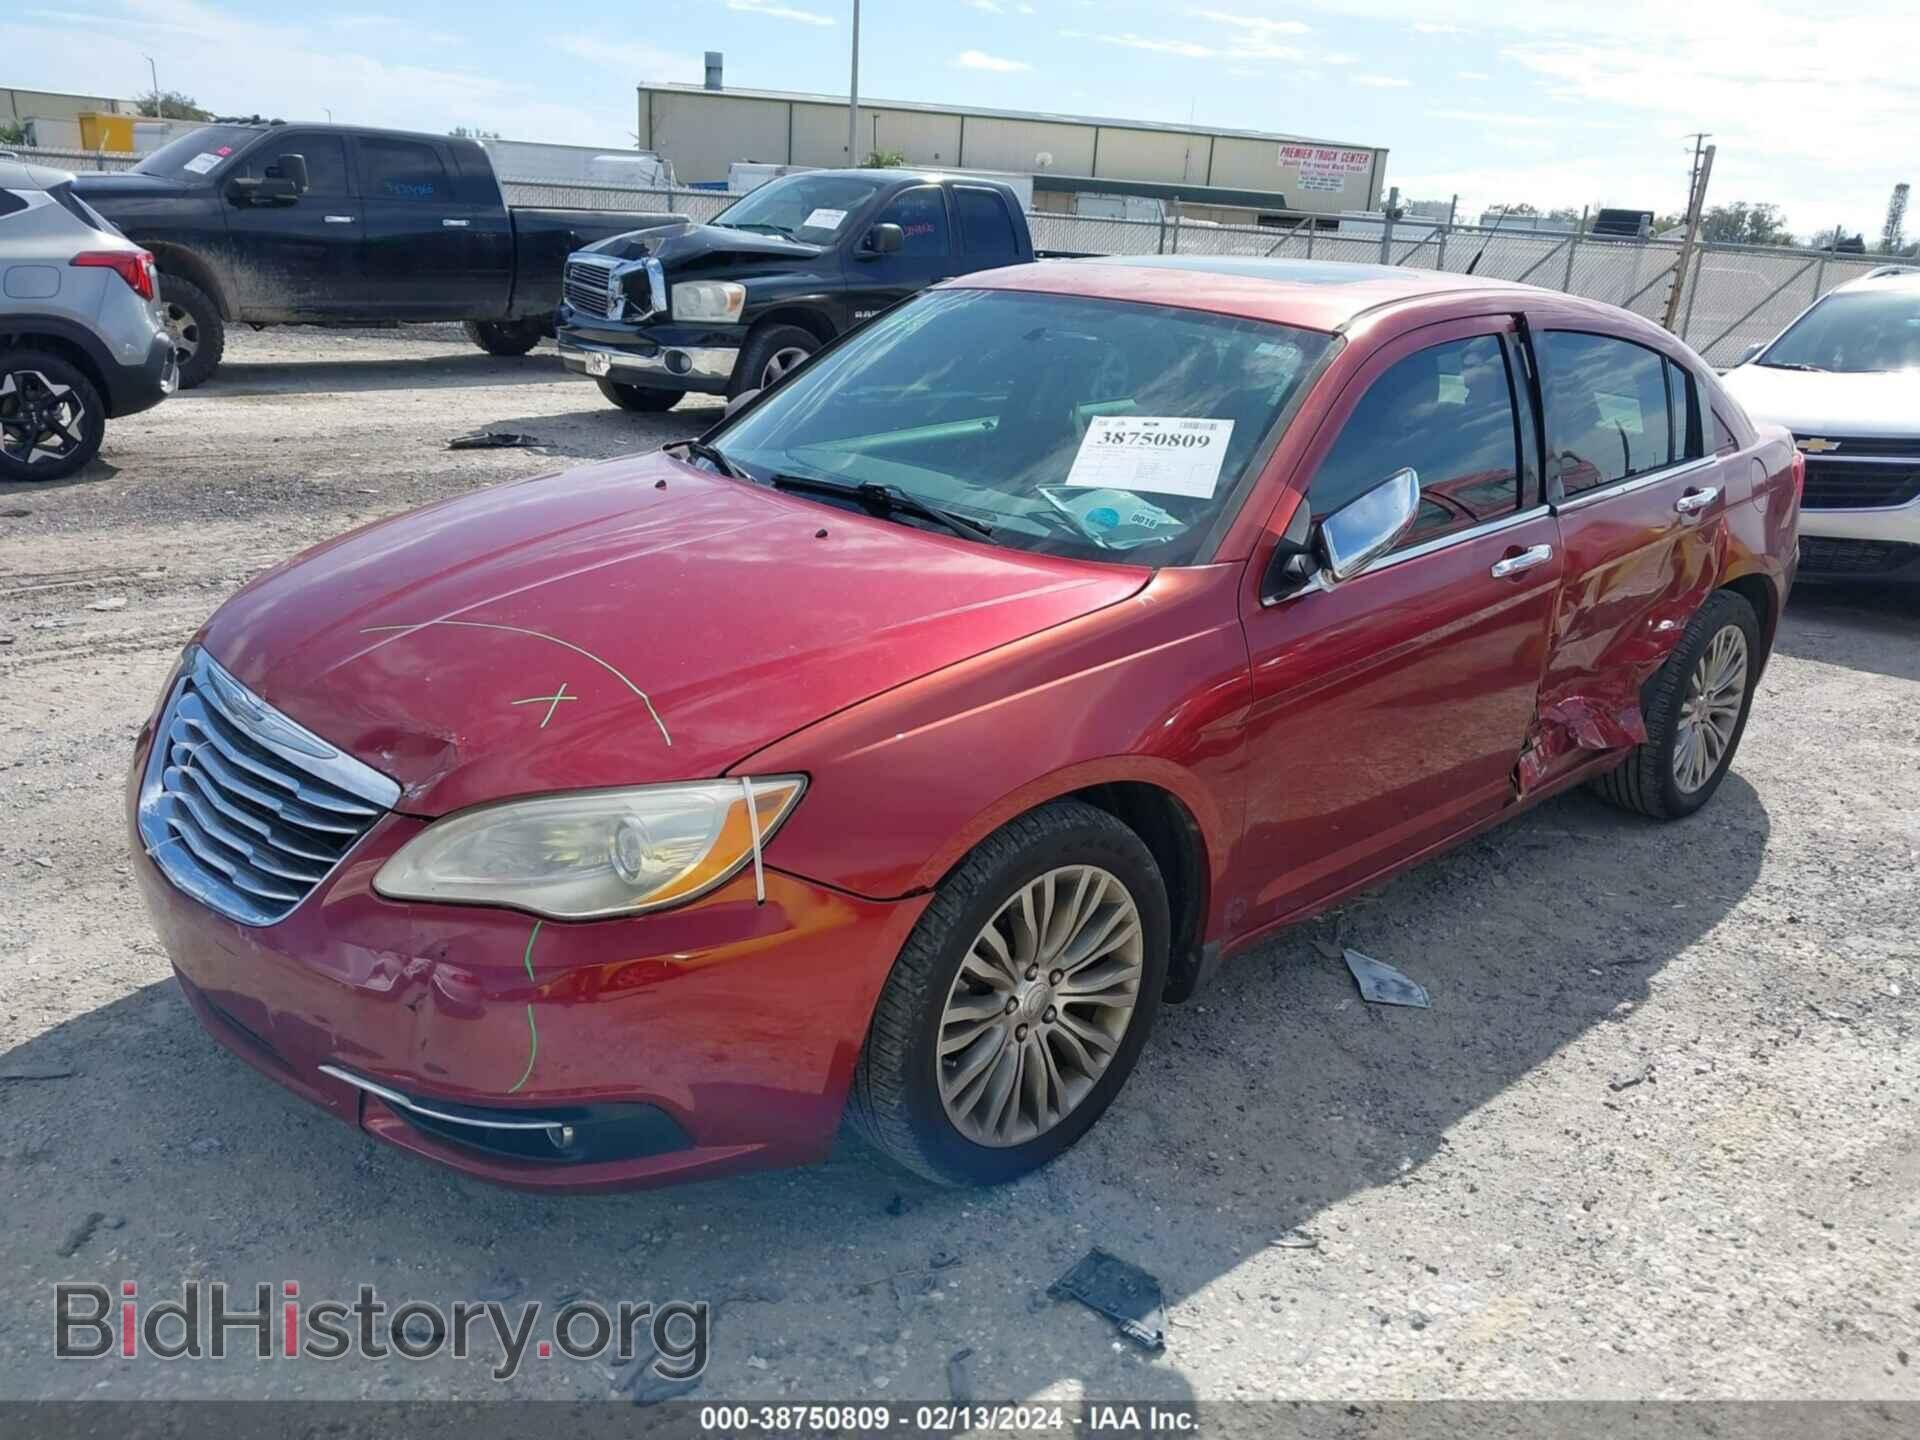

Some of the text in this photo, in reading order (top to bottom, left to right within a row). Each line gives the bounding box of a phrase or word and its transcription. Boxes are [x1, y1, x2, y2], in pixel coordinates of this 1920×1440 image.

[1280, 147, 1370, 164] PREMIER TRUCK CENTER
[1097, 431, 1210, 448] 38750809
